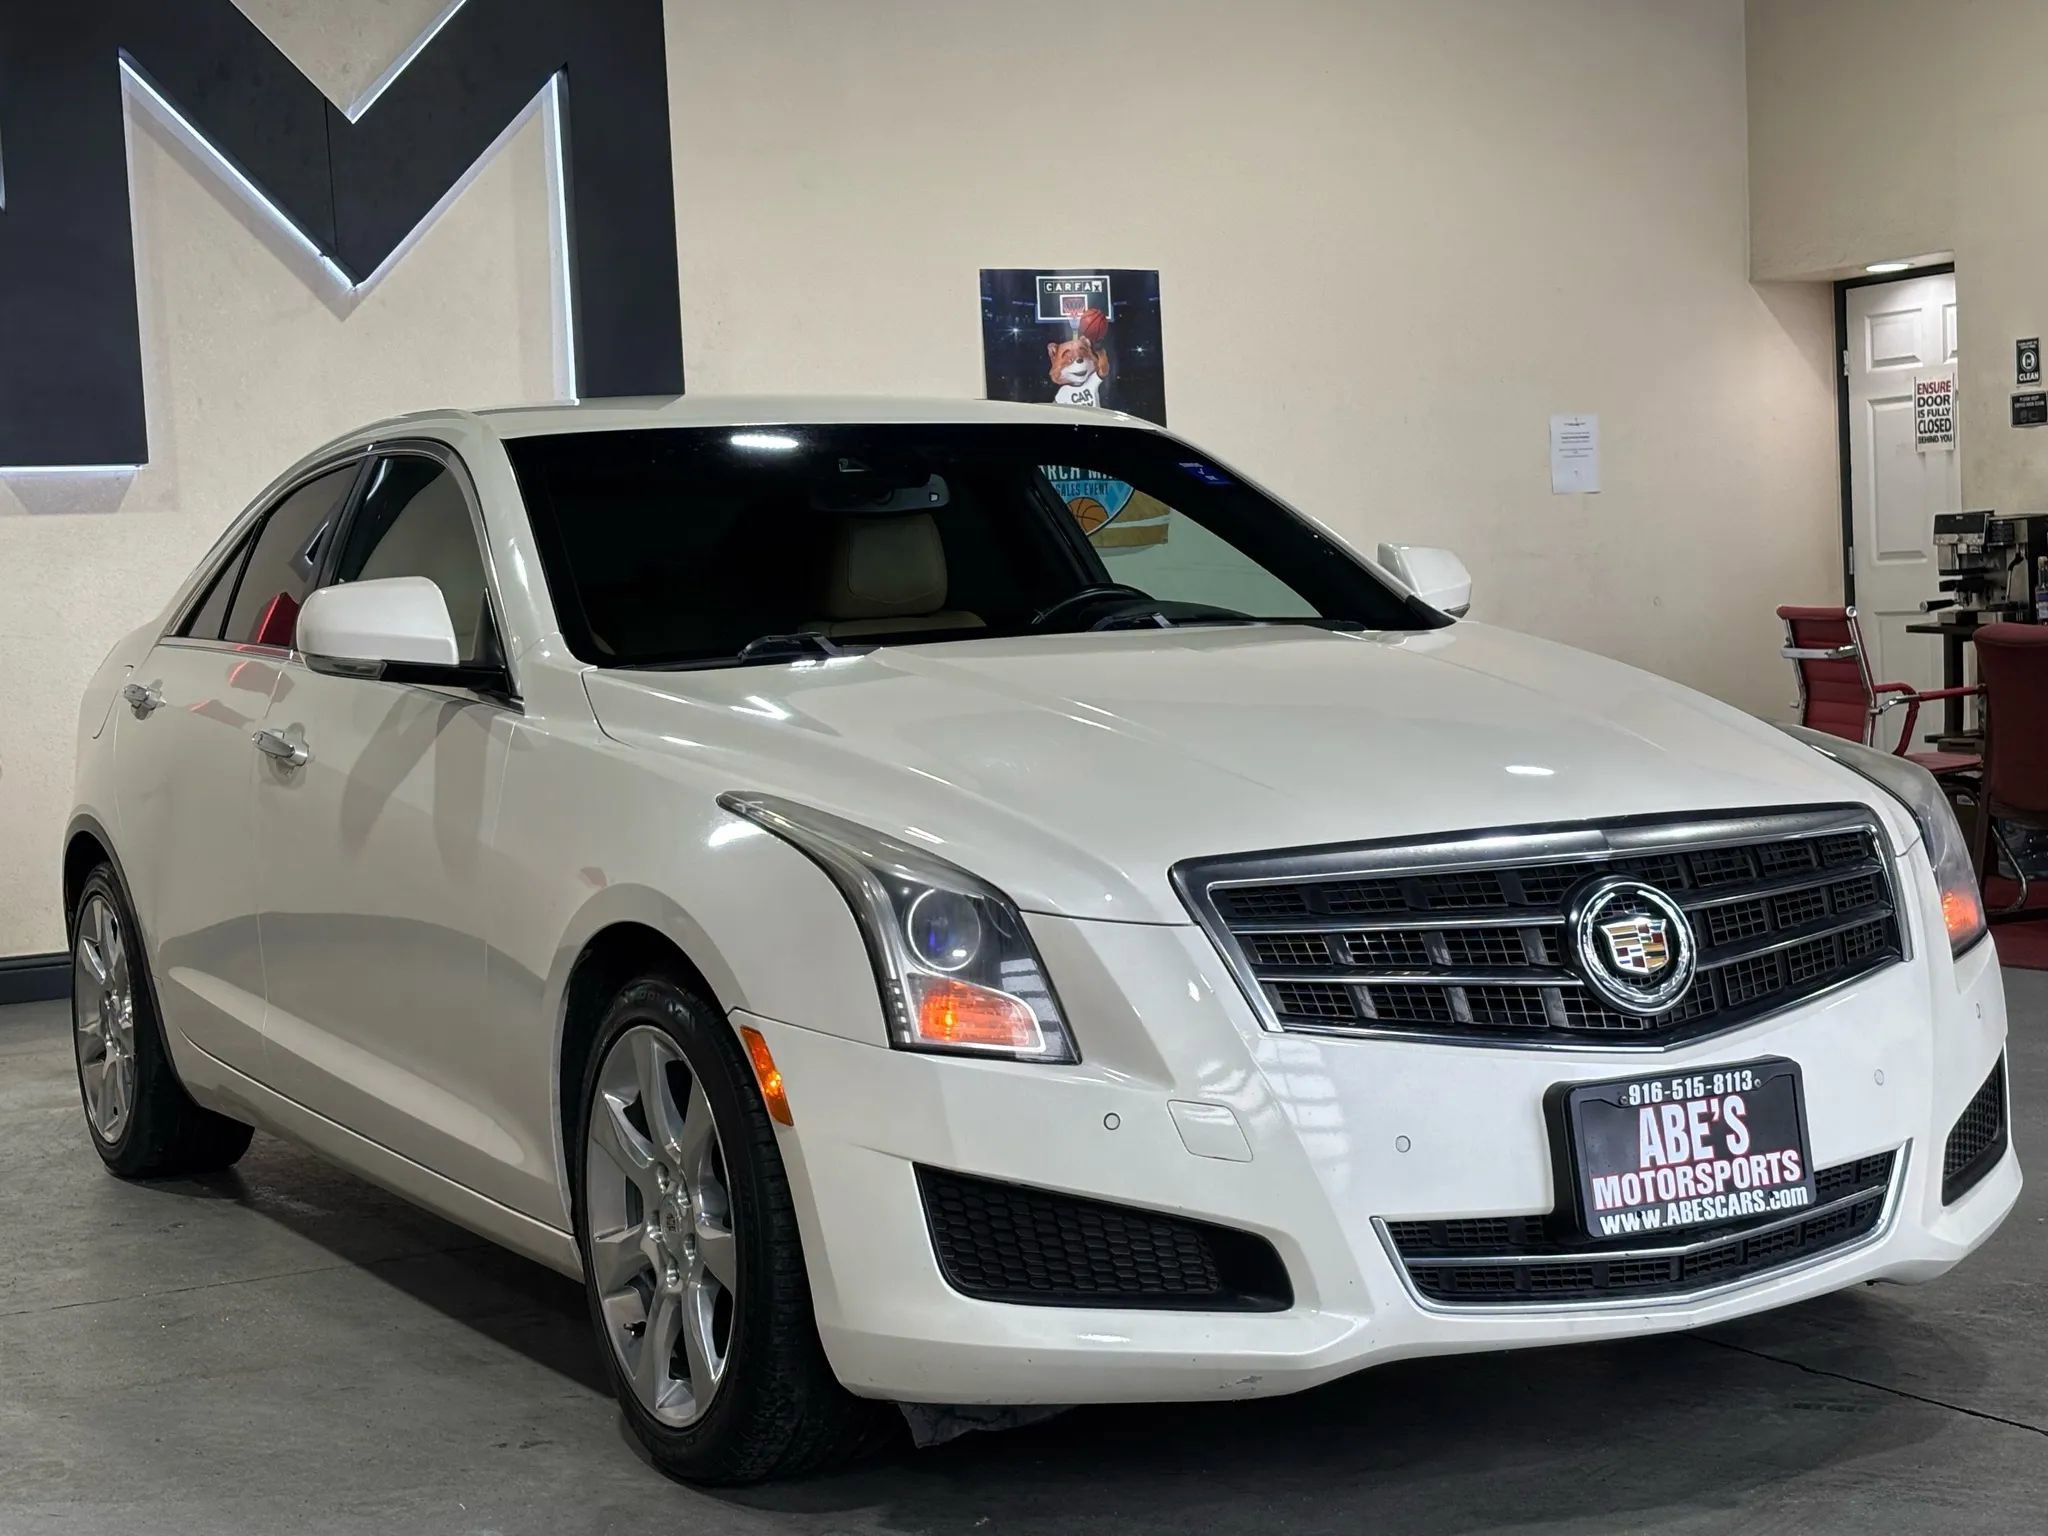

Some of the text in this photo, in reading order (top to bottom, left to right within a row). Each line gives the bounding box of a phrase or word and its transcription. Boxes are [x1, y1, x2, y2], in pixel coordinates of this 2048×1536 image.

[1046, 281, 1102, 293] CARFAX
[2018, 371, 2039, 382] CLEAN
[1917, 380, 1952, 395] ENSURE
[1071, 389, 1093, 403] CAR
[1917, 394, 1951, 408] DOOR
[1917, 407, 1951, 419] IS FULLY
[1918, 418, 1952, 434] CLOSED
[1918, 433, 1952, 445] BEHIND YOU
[1056, 482, 1109, 497] SALES EVENT
[1628, 1070, 1753, 1106] 916-515-8113
[1639, 1095, 1750, 1168] ABE'S
[1592, 1149, 1801, 1211] MOTORSPORTS
